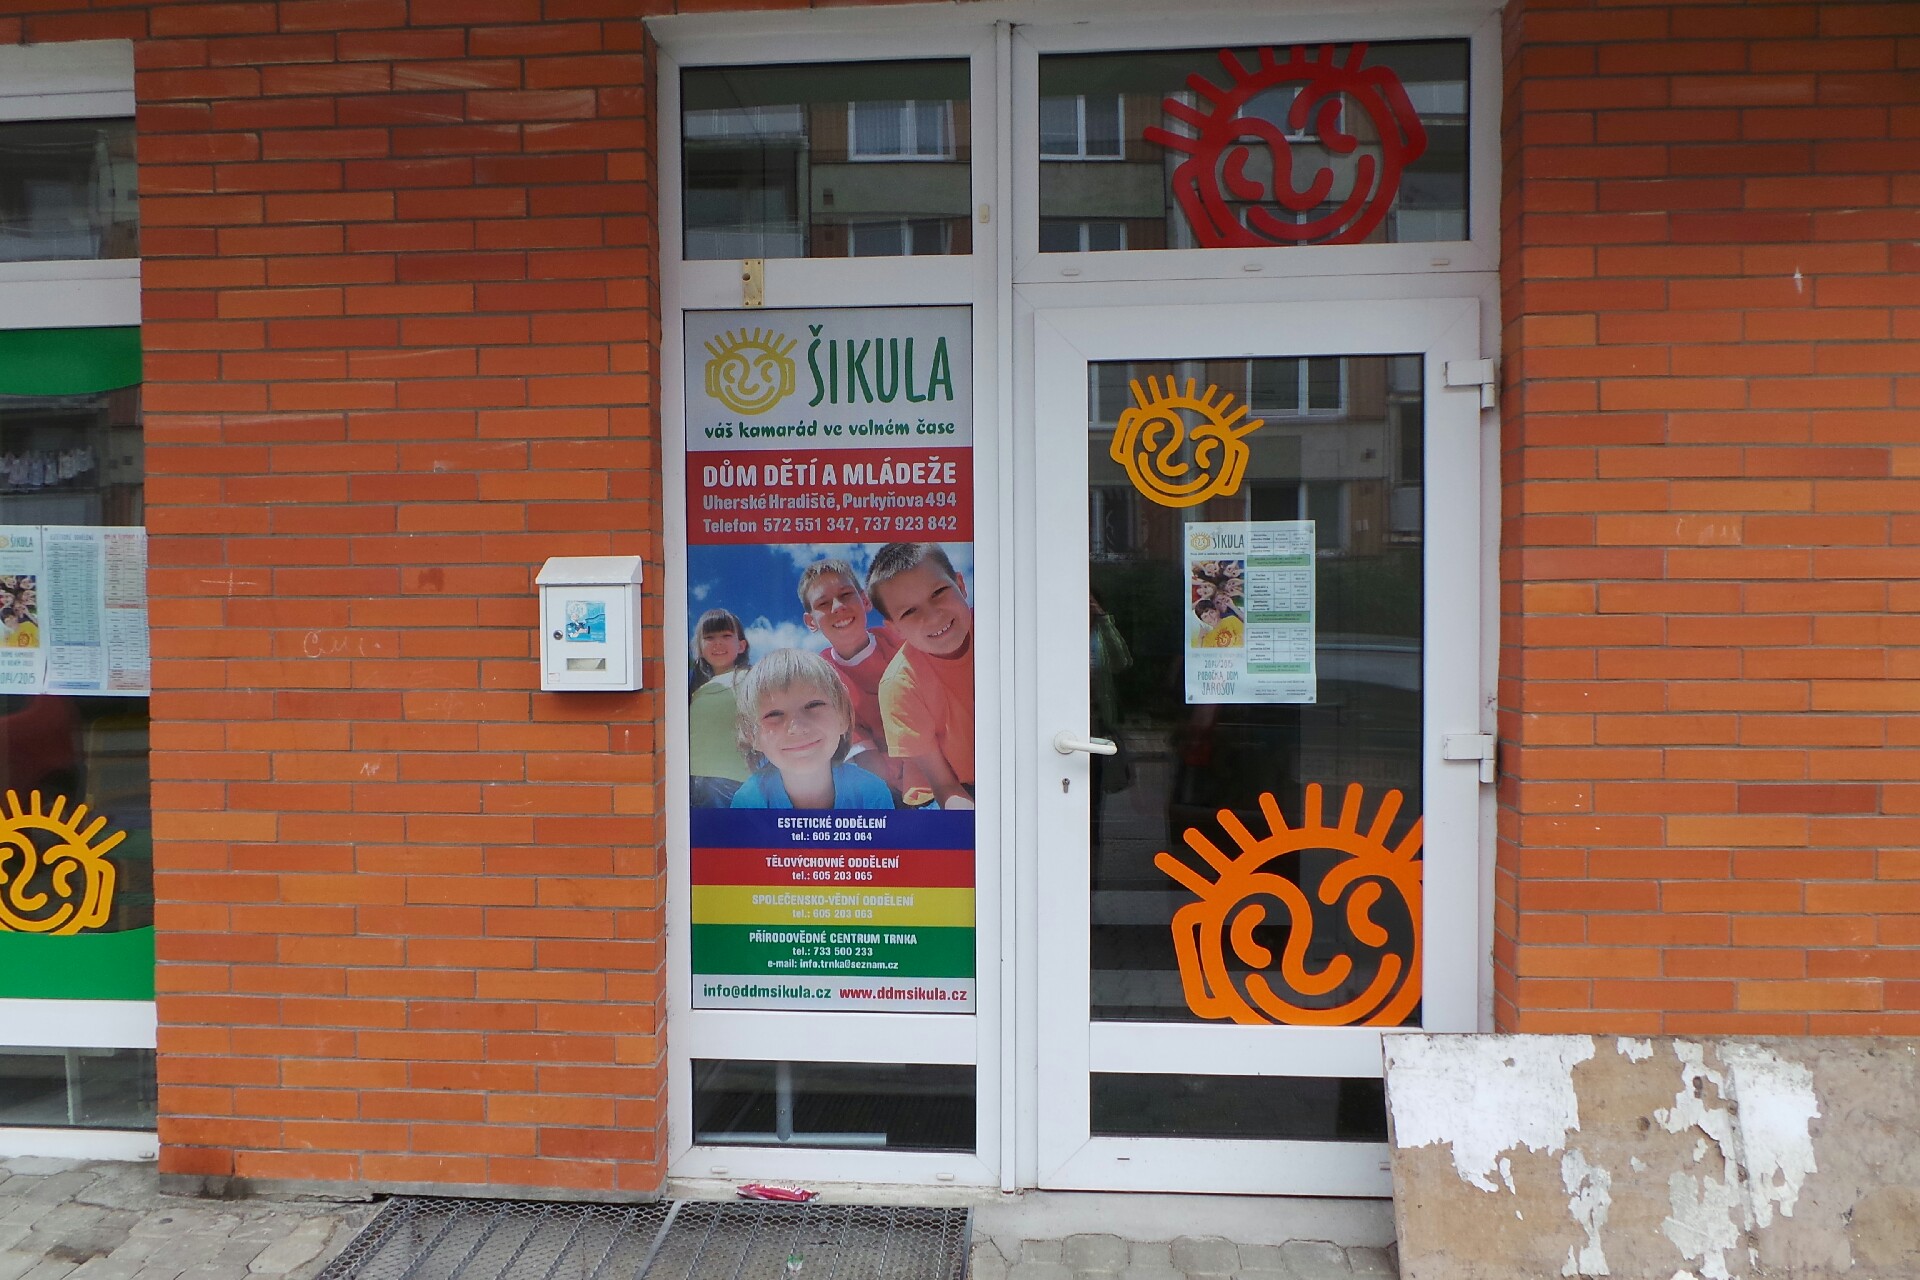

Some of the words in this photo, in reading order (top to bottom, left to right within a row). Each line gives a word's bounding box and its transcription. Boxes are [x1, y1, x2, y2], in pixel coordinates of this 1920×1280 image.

[807, 324, 954, 408] ŠIKULA
[704, 422, 734, 439] váš
[738, 419, 818, 439] kamarád
[823, 424, 843, 436] ve
[848, 418, 910, 436] volném
[916, 418, 955, 435] čase
[703, 459, 757, 488] DŮM
[763, 457, 818, 487] DĚTÍ
[821, 463, 837, 486] A
[842, 455, 957, 486] MLÁDEŽE
[702, 492, 767, 511] Uherské
[767, 492, 841, 511] Hradiště,
[842, 491, 925, 512] Purkyňova
[923, 491, 957, 508] 494
[703, 518, 758, 533] Telefon
[762, 517, 793, 533] 572
[794, 517, 822, 532] 551
[826, 516, 859, 534] 347,
[863, 516, 891, 531] 737
[894, 515, 924, 531] 923
[927, 515, 958, 531] 842
[777, 815, 832, 829] ESTETICKÉ
[834, 815, 887, 829] ODDĚLENÍ
[791, 831, 810, 841] tel.:
[812, 831, 831, 841] 605
[833, 831, 852, 841] 203
[854, 831, 873, 841] 064
[765, 854, 845, 868] TĚLOVÝCHOVNÉ
[847, 854, 900, 869] ODDĚLENÍ
[791, 871, 811, 881] tel.:
[812, 870, 831, 881] 605
[833, 870, 852, 881] 203
[853, 871, 873, 881] 065
[751, 892, 859, 907] SPOLEČENSKO-VĚDNÍ
[861, 892, 915, 907] ODDĚLENÍ
[791, 909, 811, 919] tel.:
[812, 908, 832, 919] 605
[834, 909, 854, 919] 203
[854, 909, 874, 919] 063
[749, 929, 827, 944] PŘÍRODOVĚDNÉ
[829, 932, 881, 944] CENTRUM
[883, 933, 918, 945] TRNKA
[792, 946, 811, 956] tel.:
[813, 946, 831, 956] 733
[834, 946, 853, 956] 500
[854, 947, 873, 957] 233
[767, 958, 798, 969] e-mail:
[799, 958, 899, 970] info.trnka@seznam.cz
[703, 983, 832, 999] info@ddmsikula.cz
[839, 986, 968, 1001] www.ddmsikula.cz
